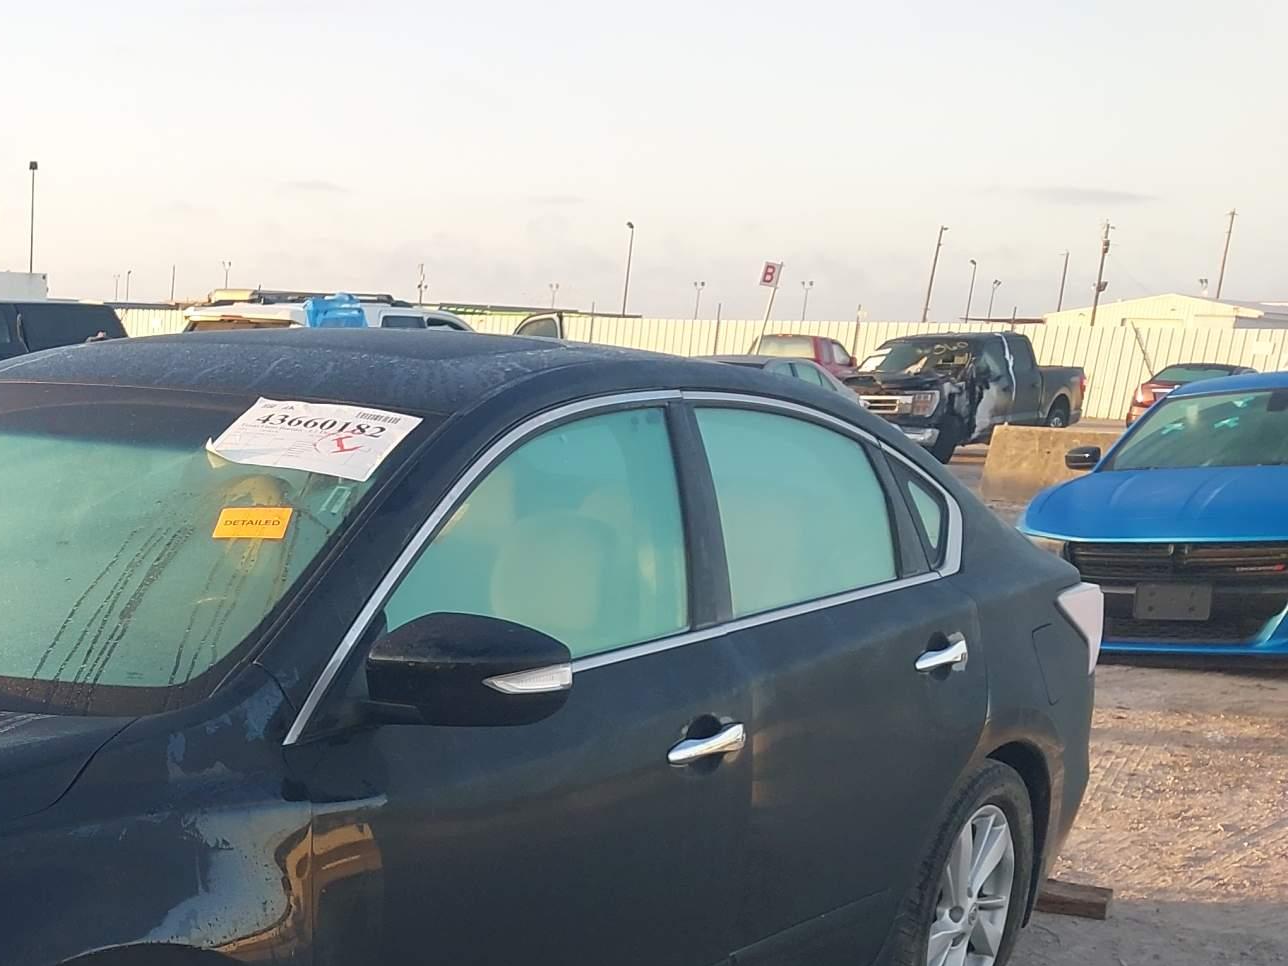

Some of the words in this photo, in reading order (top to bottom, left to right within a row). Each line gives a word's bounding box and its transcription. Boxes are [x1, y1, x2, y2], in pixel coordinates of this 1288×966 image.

[762, 264, 776, 283] B
[256, 412, 387, 439] 43660182
[223, 518, 281, 527] DETAILED
